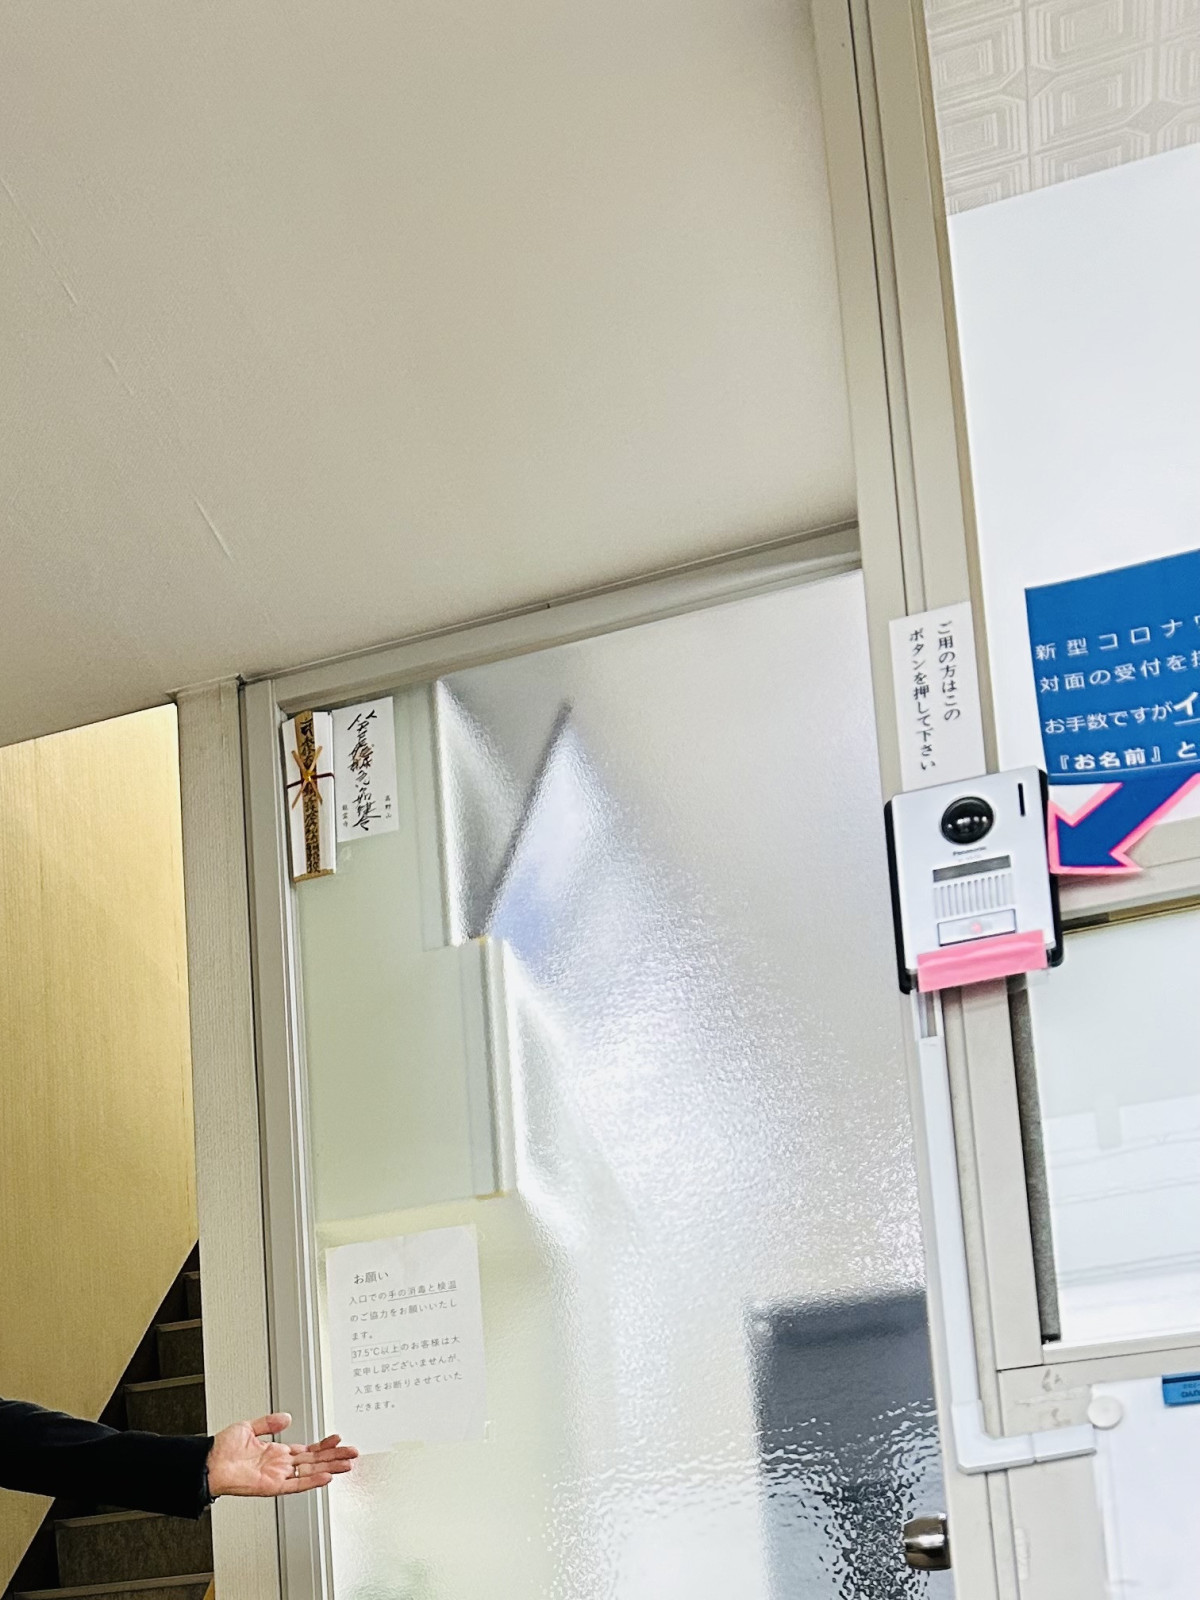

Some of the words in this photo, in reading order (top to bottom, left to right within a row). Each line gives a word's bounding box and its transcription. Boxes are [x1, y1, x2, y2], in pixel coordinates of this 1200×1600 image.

[909, 627, 936, 771] ボタンを押して下さい
[937, 620, 961, 721] ご用の方はこの
[353, 1271, 389, 1285] お願い
